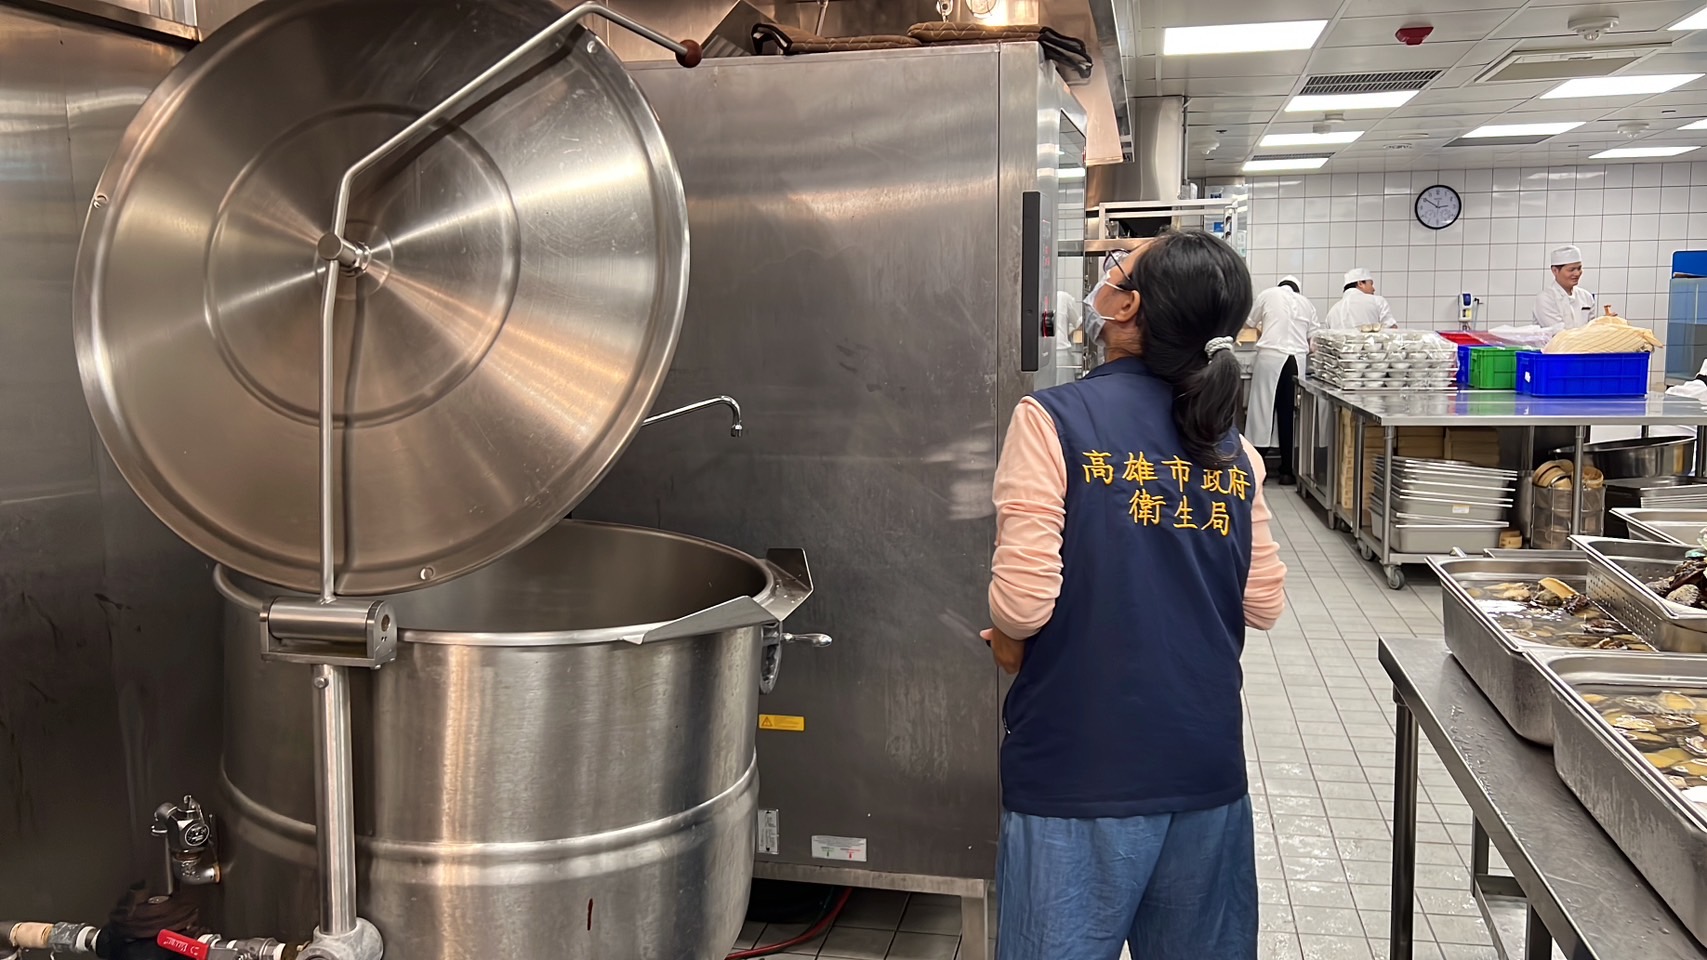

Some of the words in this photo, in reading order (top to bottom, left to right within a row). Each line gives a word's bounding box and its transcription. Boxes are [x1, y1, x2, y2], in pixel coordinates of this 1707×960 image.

[1082, 450, 1251, 500] 高雄市政府
[1128, 488, 1230, 536] 衛生局
